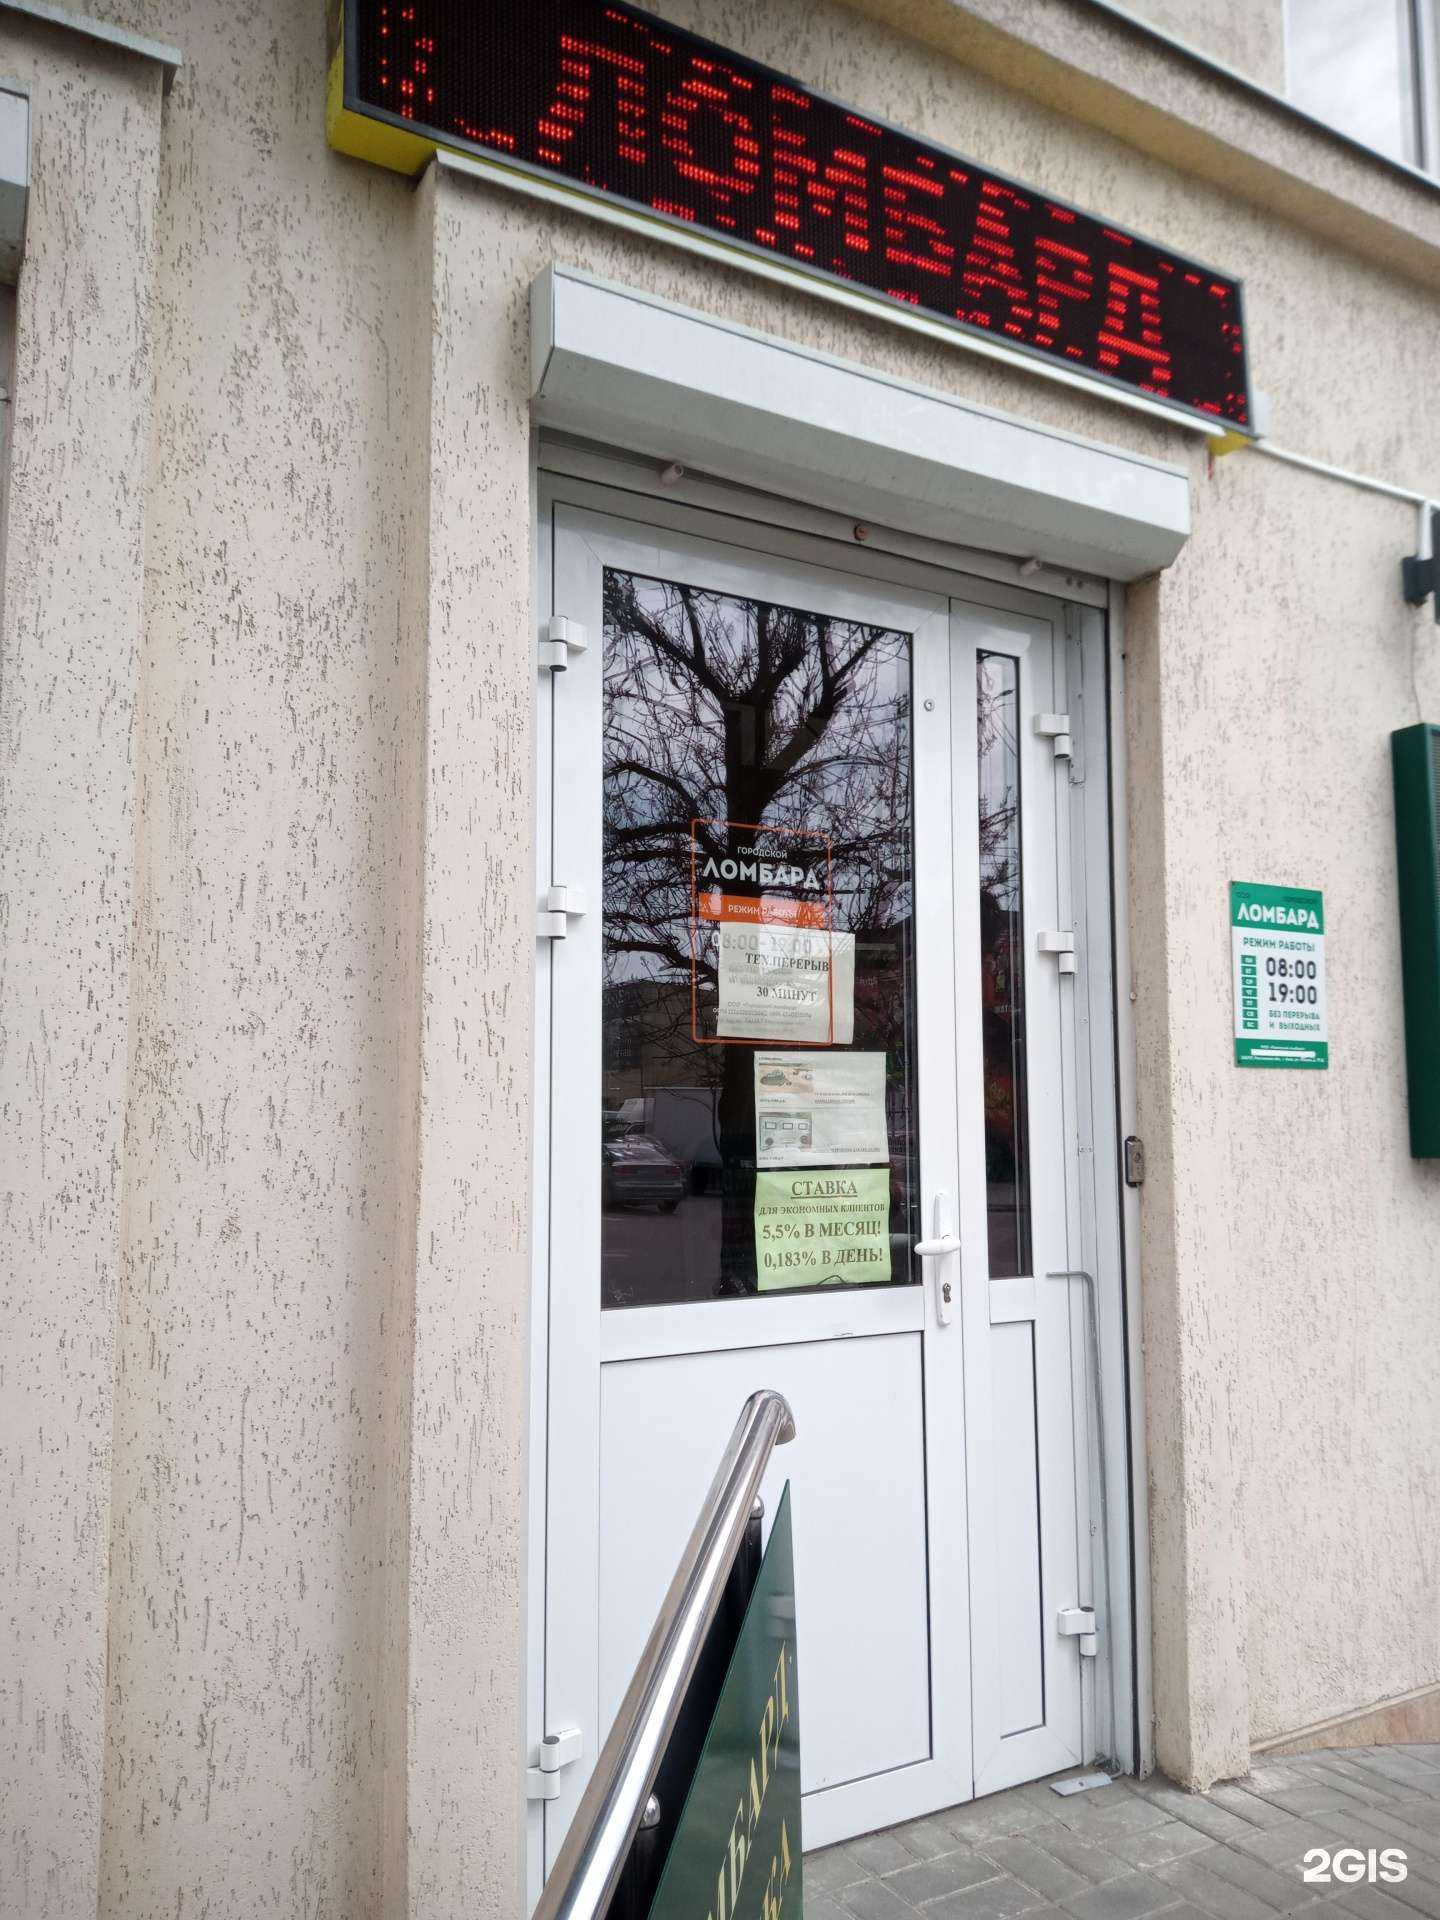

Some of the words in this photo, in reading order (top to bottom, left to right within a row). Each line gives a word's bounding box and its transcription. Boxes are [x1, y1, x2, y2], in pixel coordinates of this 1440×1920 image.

[536, 34, 1173, 400] ЛОМБАРД
[737, 845, 788, 859] ГОРОДСКОЙ
[703, 857, 821, 890] ЛОМБАРД
[728, 904, 760, 915] РЕЖИМ
[1237, 902, 1319, 929] ЛОМБАРД
[1243, 936, 1276, 949] РЕЖИМ
[1279, 940, 1315, 952] РАБОТЫ
[1266, 957, 1317, 979] 08:00
[756, 985, 769, 998] 30
[771, 987, 817, 1002] МИНУТ
[1268, 982, 1318, 1004] 19:00
[1269, 1009, 1281, 1019] БЕЗ
[1282, 1010, 1320, 1020] ПЕРЕРЫВА
[1269, 1021, 1275, 1029] И
[1279, 1022, 1320, 1032] ВЫХОДНЫХ
[791, 1180, 858, 1197] СТАВКА
[758, 1206, 778, 1217] ДЛЯ
[780, 1204, 839, 1215] ЭКОНОМНЫХ
[840, 1203, 885, 1213] КЛИЕНТОВ
[762, 1223, 800, 1241] 5,5%
[804, 1223, 816, 1238] В
[818, 1220, 882, 1238] МЕСЯЦ!
[764, 1250, 817, 1273] 0,183%
[822, 1249, 832, 1264] В
[834, 1246, 883, 1265] ДЕНЬ!
